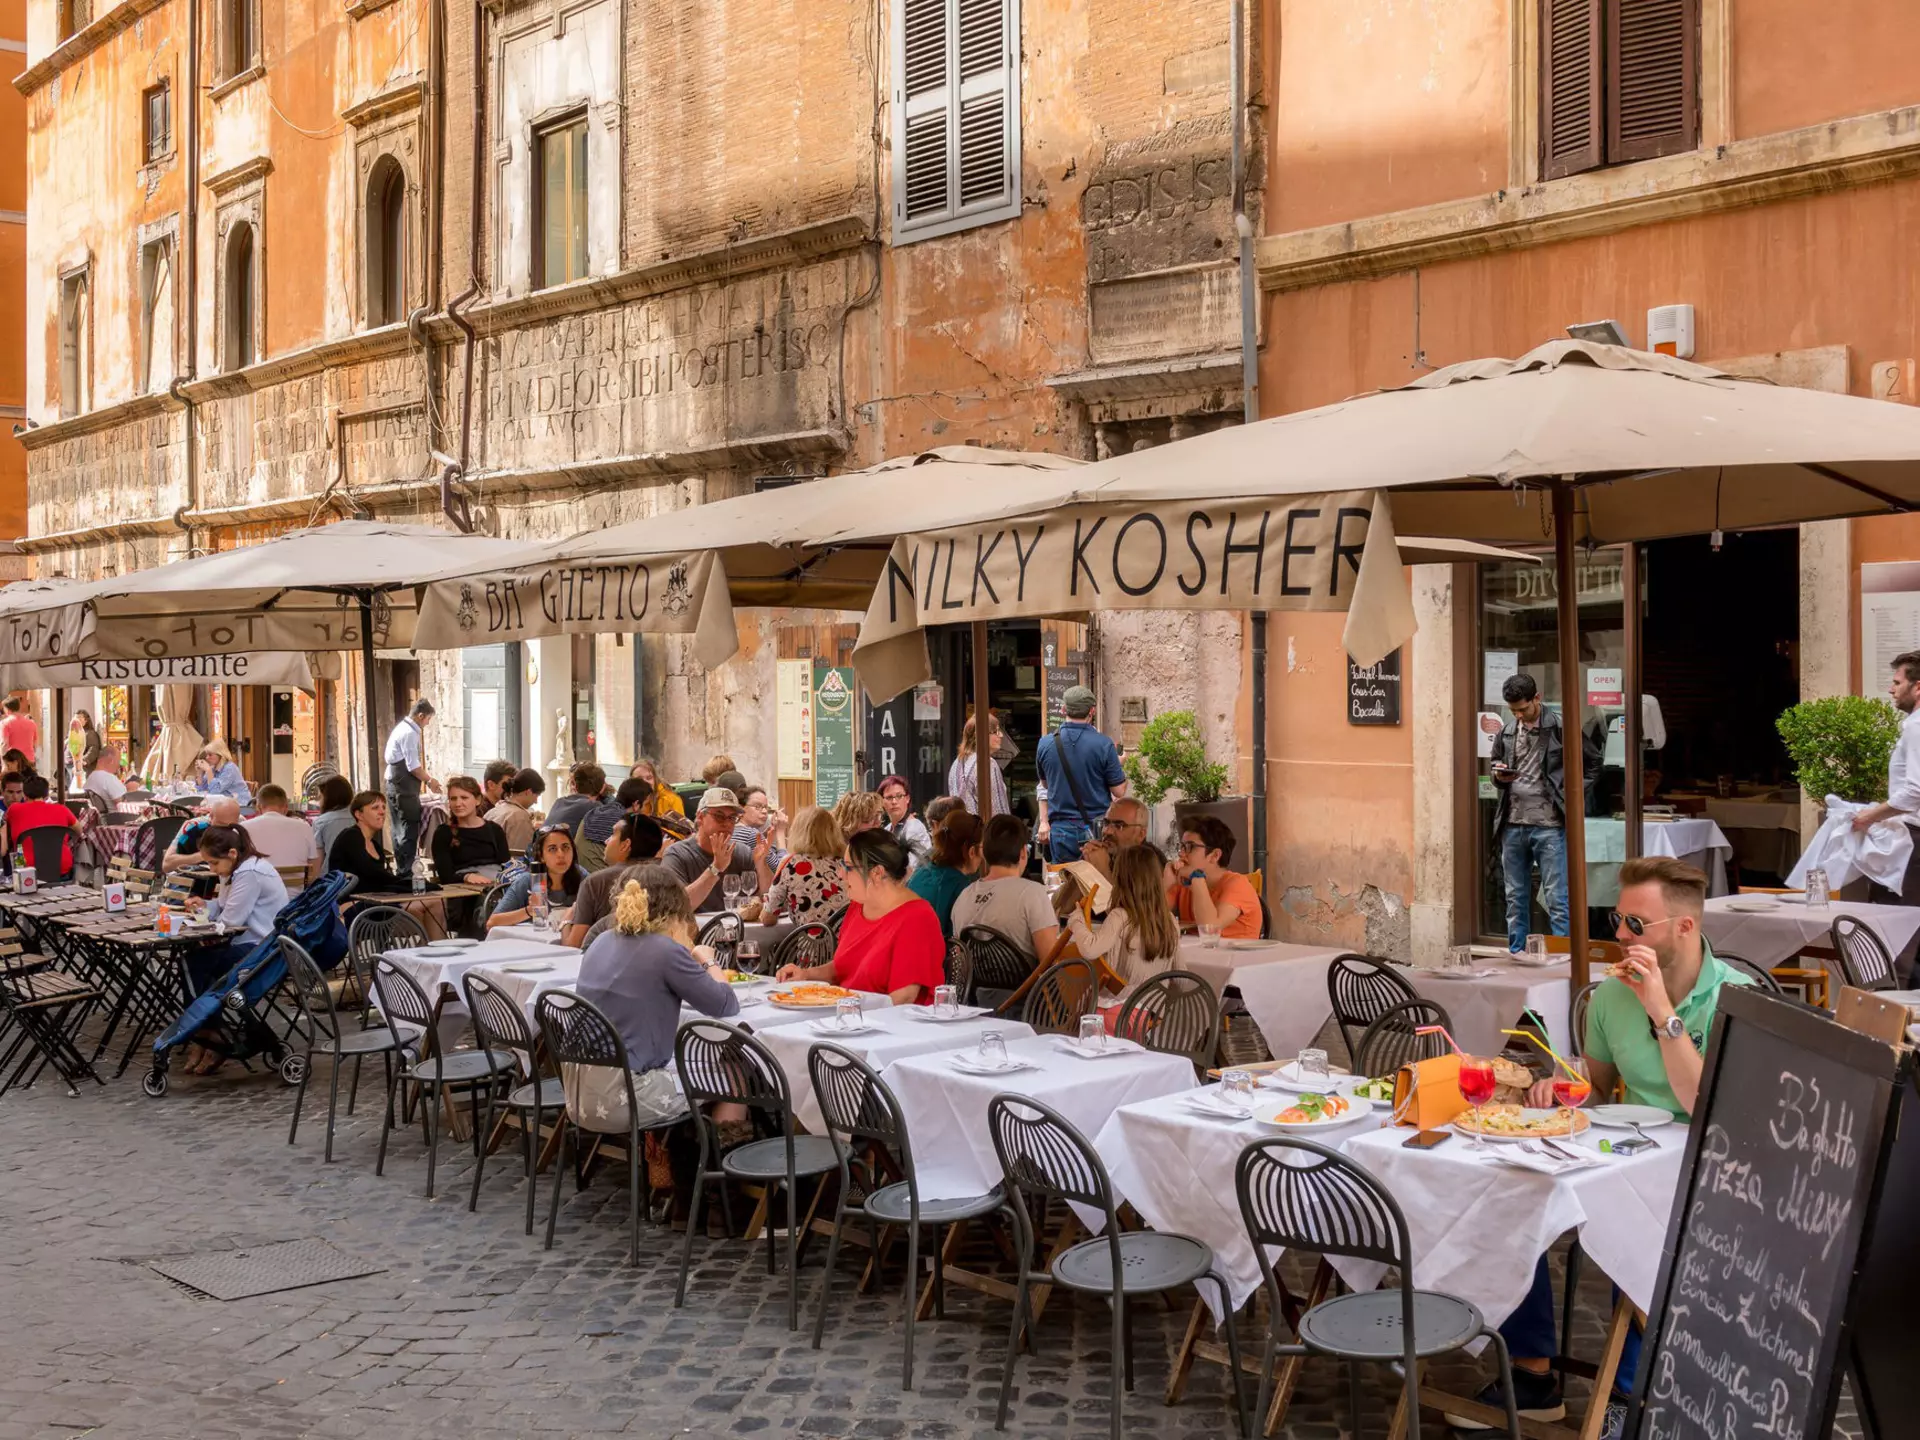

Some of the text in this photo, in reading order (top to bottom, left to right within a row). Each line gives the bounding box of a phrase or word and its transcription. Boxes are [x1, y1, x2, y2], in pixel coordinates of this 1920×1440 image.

[888, 507, 1372, 623] MILKY KOSHER
[540, 564, 651, 624] GHETTO
[80, 653, 249, 681] Ristorante
[1593, 676, 1616, 684] OPEN
